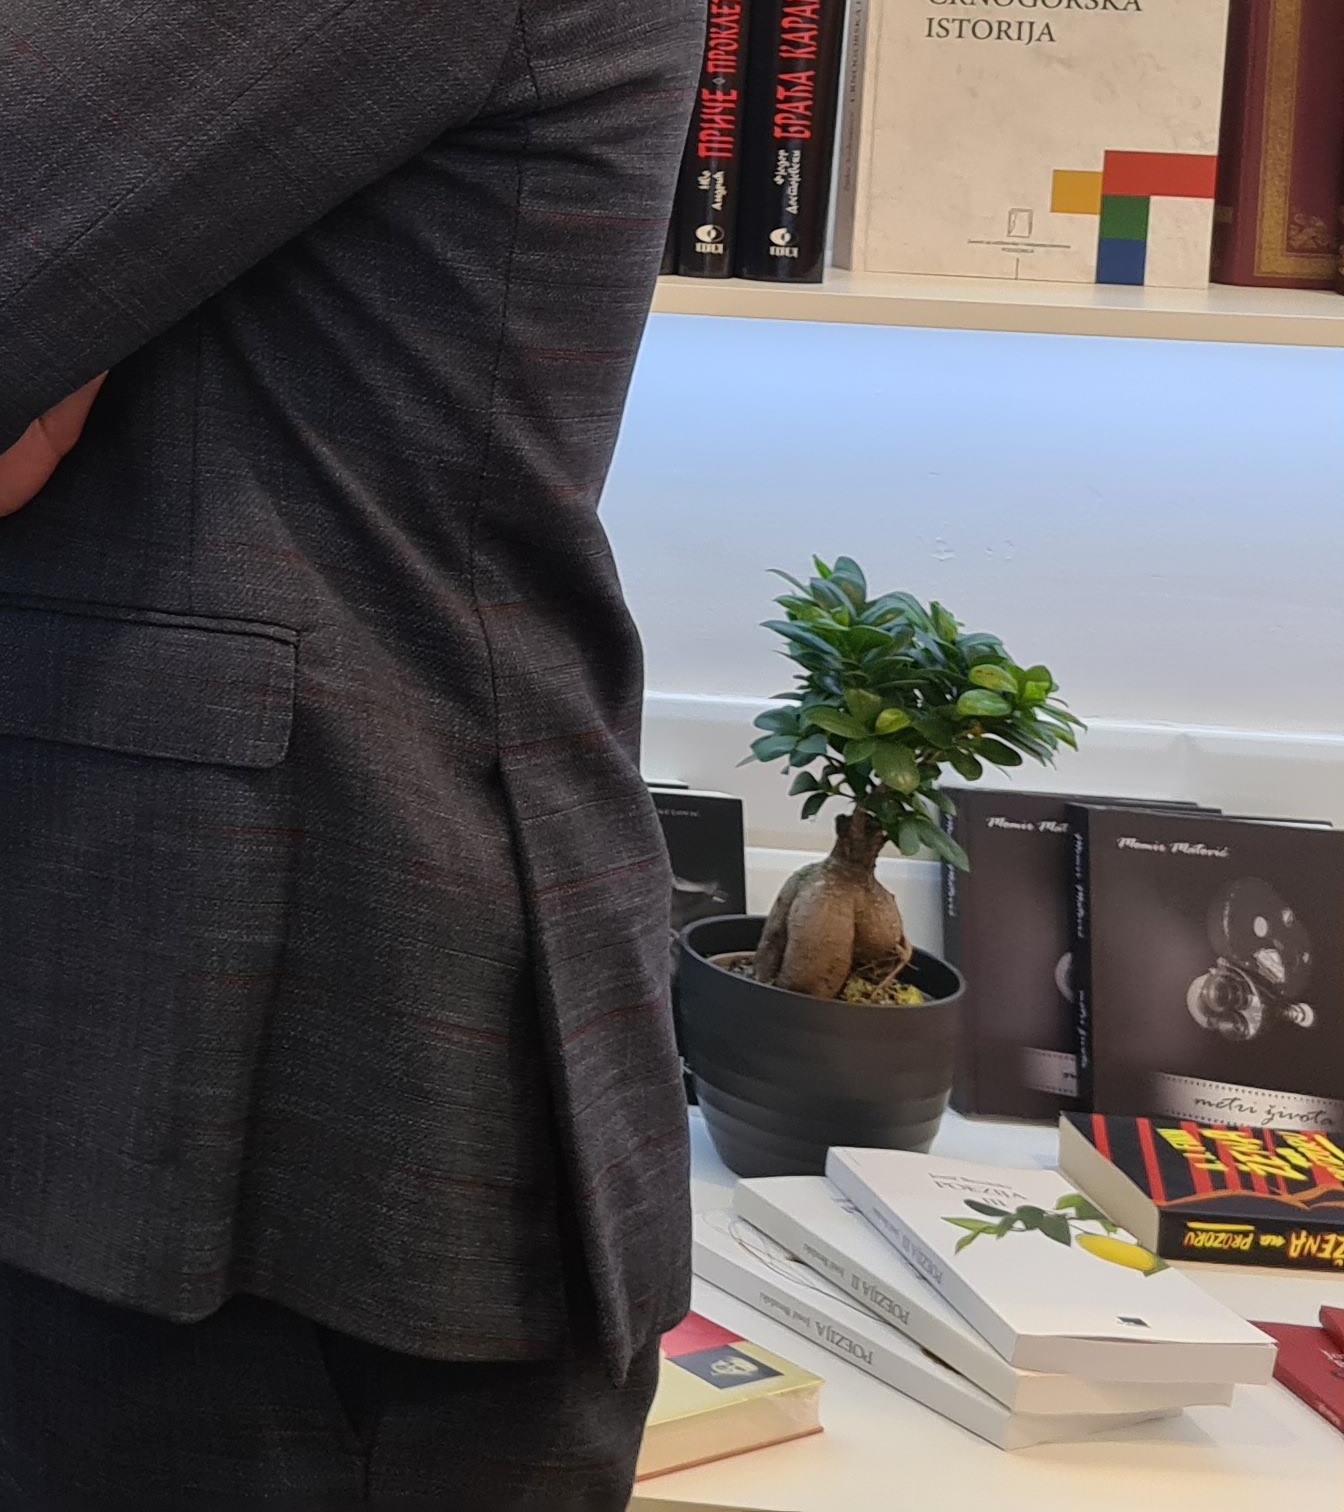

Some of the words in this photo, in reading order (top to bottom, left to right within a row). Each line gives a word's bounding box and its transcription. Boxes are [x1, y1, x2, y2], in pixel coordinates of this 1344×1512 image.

[925, 17, 1056, 45] ISTORIJA
[773, 70, 816, 140] БРАЋА
[698, 88, 739, 160] ПРИЧЕ
[986, 816, 1035, 832] Momir
[1117, 837, 1166, 852] Momir
[1170, 841, 1230, 858] Matović
[1194, 1094, 1258, 1116] metri
[1261, 1104, 1335, 1127] života
[1183, 1231, 1254, 1251] PROZORU
[863, 1286, 910, 1326] POEZIJA
[815, 1320, 874, 1365] POEZIJA
